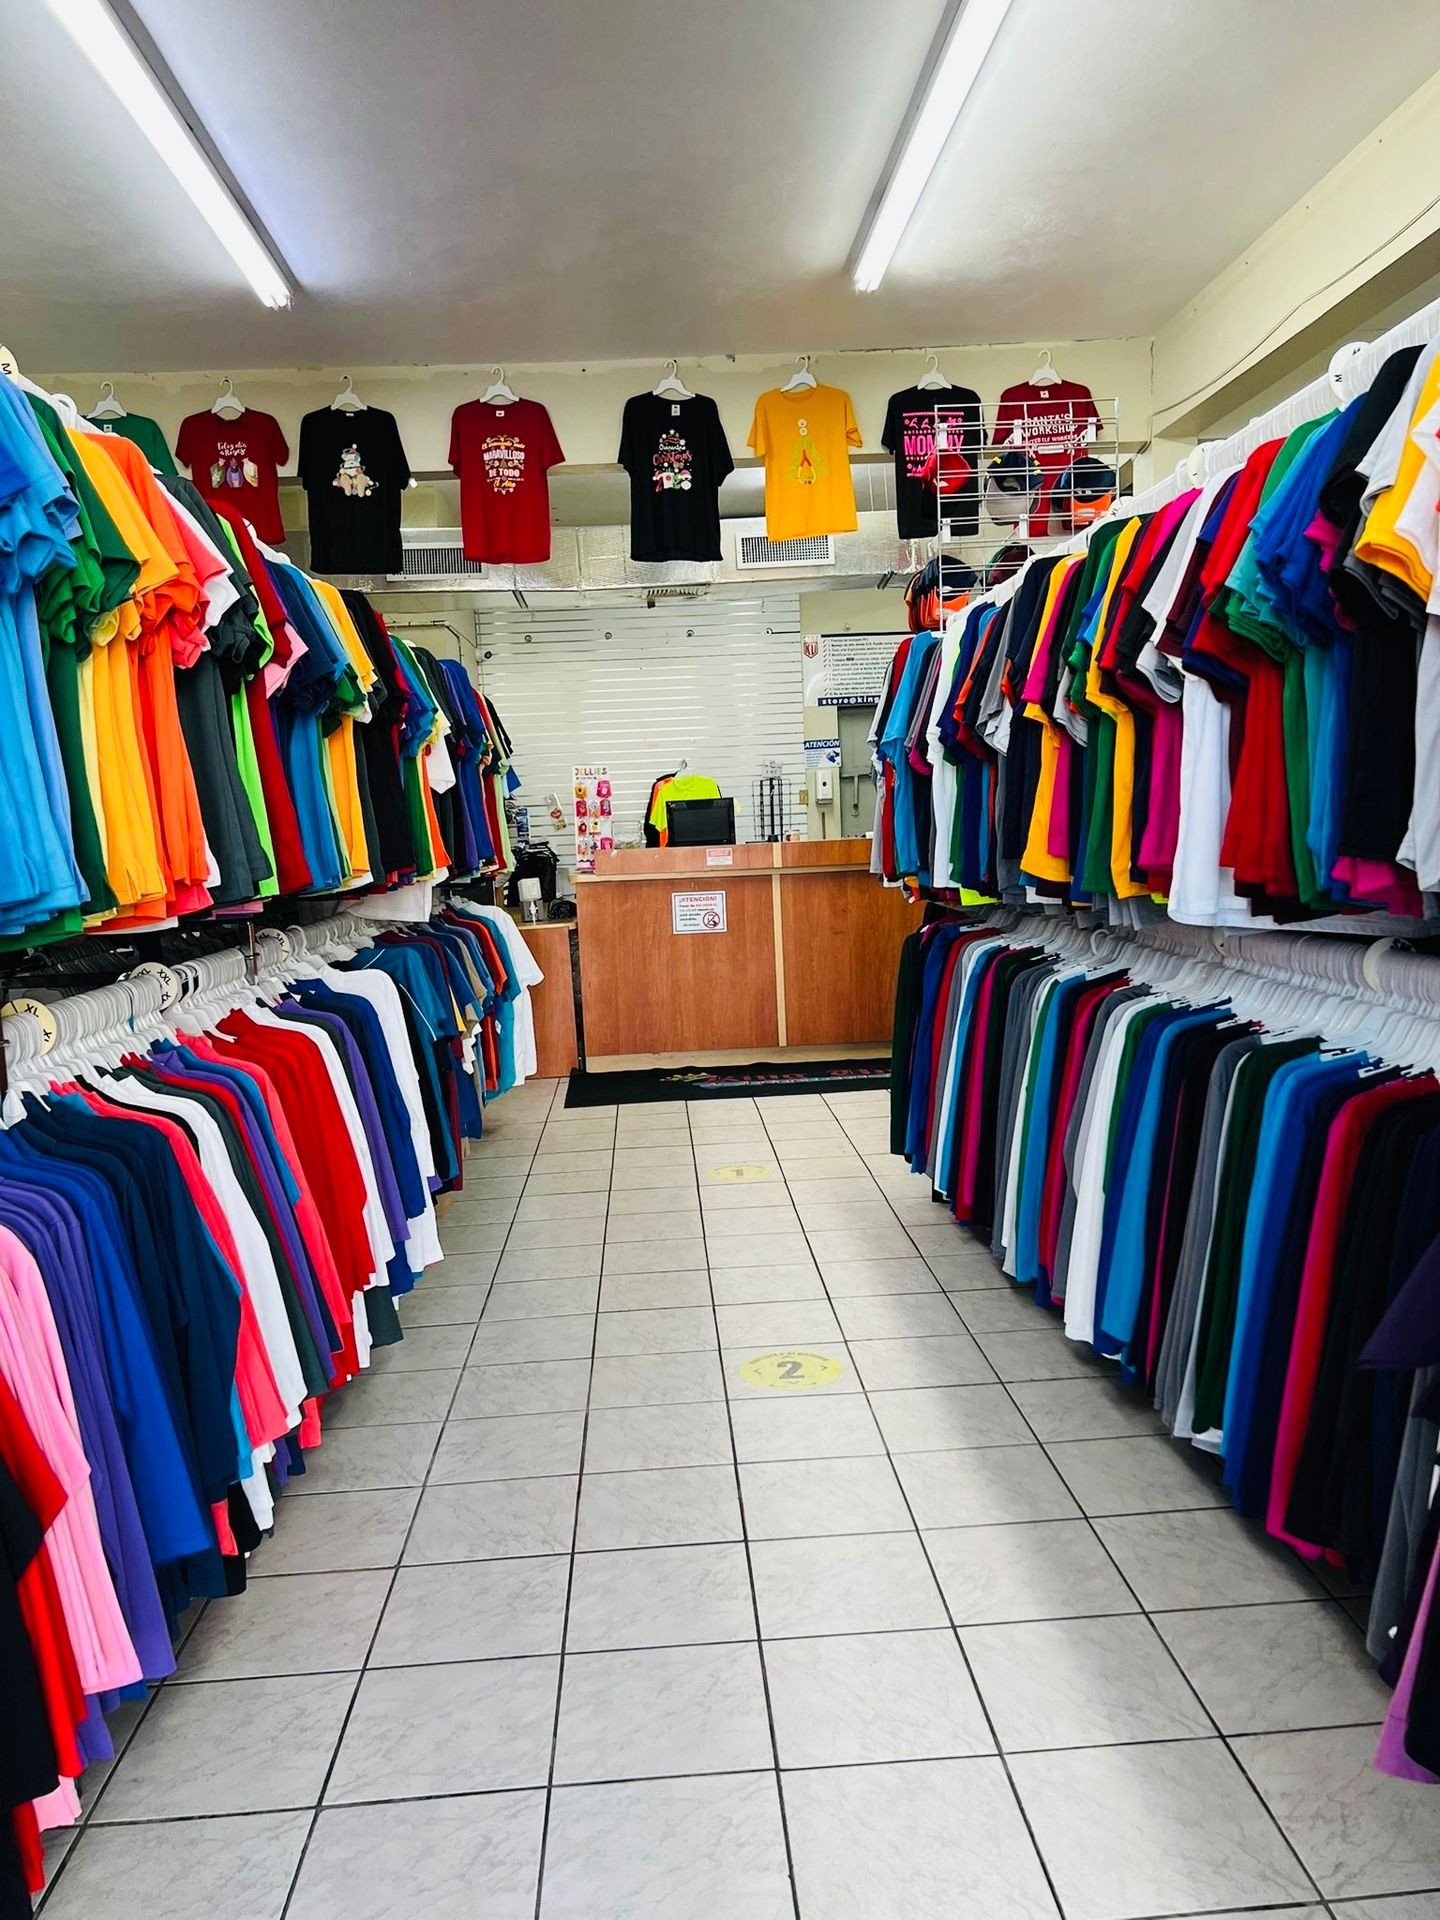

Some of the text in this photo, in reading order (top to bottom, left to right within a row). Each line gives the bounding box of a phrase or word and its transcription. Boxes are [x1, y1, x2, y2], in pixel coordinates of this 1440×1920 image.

[1, 362, 12, 375] M
[483, 449, 526, 461] MARAVILLOSO
[488, 467, 521, 478] DE TODO
[574, 767, 608, 777] JELLIES
[157, 968, 171, 986] XXL
[23, 1003, 40, 1018] XL
[776, 1359, 805, 1380] 2
